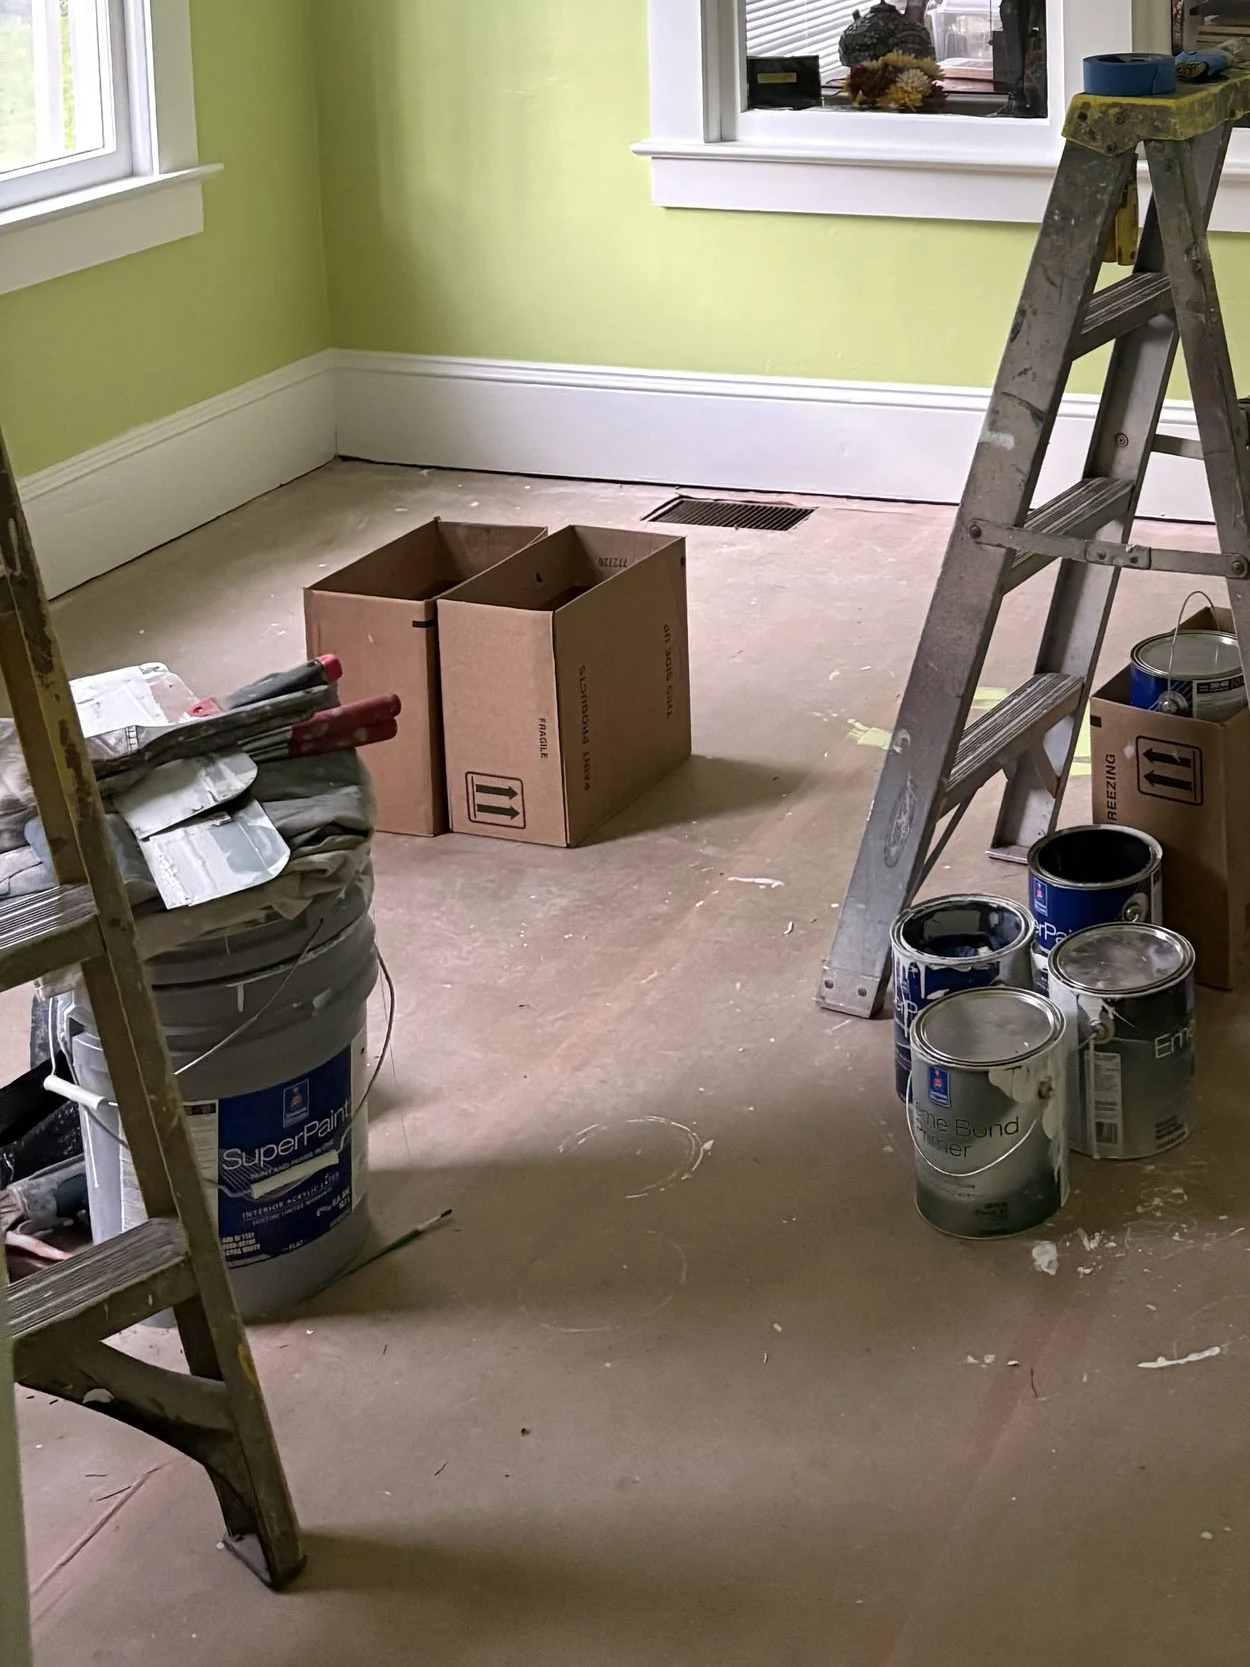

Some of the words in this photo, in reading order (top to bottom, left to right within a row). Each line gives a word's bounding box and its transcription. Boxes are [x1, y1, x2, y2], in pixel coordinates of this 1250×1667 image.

[663, 624, 671, 643] UP
[664, 647, 672, 682] SIDE
[578, 664, 590, 745] PRODUCTS
[538, 717, 548, 759] FRAGILE
[582, 751, 591, 791] PAINT
[1105, 753, 1117, 822] REEZING
[222, 1098, 351, 1170] SuperPaint
[955, 1116, 1019, 1138] Bond
[242, 1200, 284, 1220] INTERIOR
